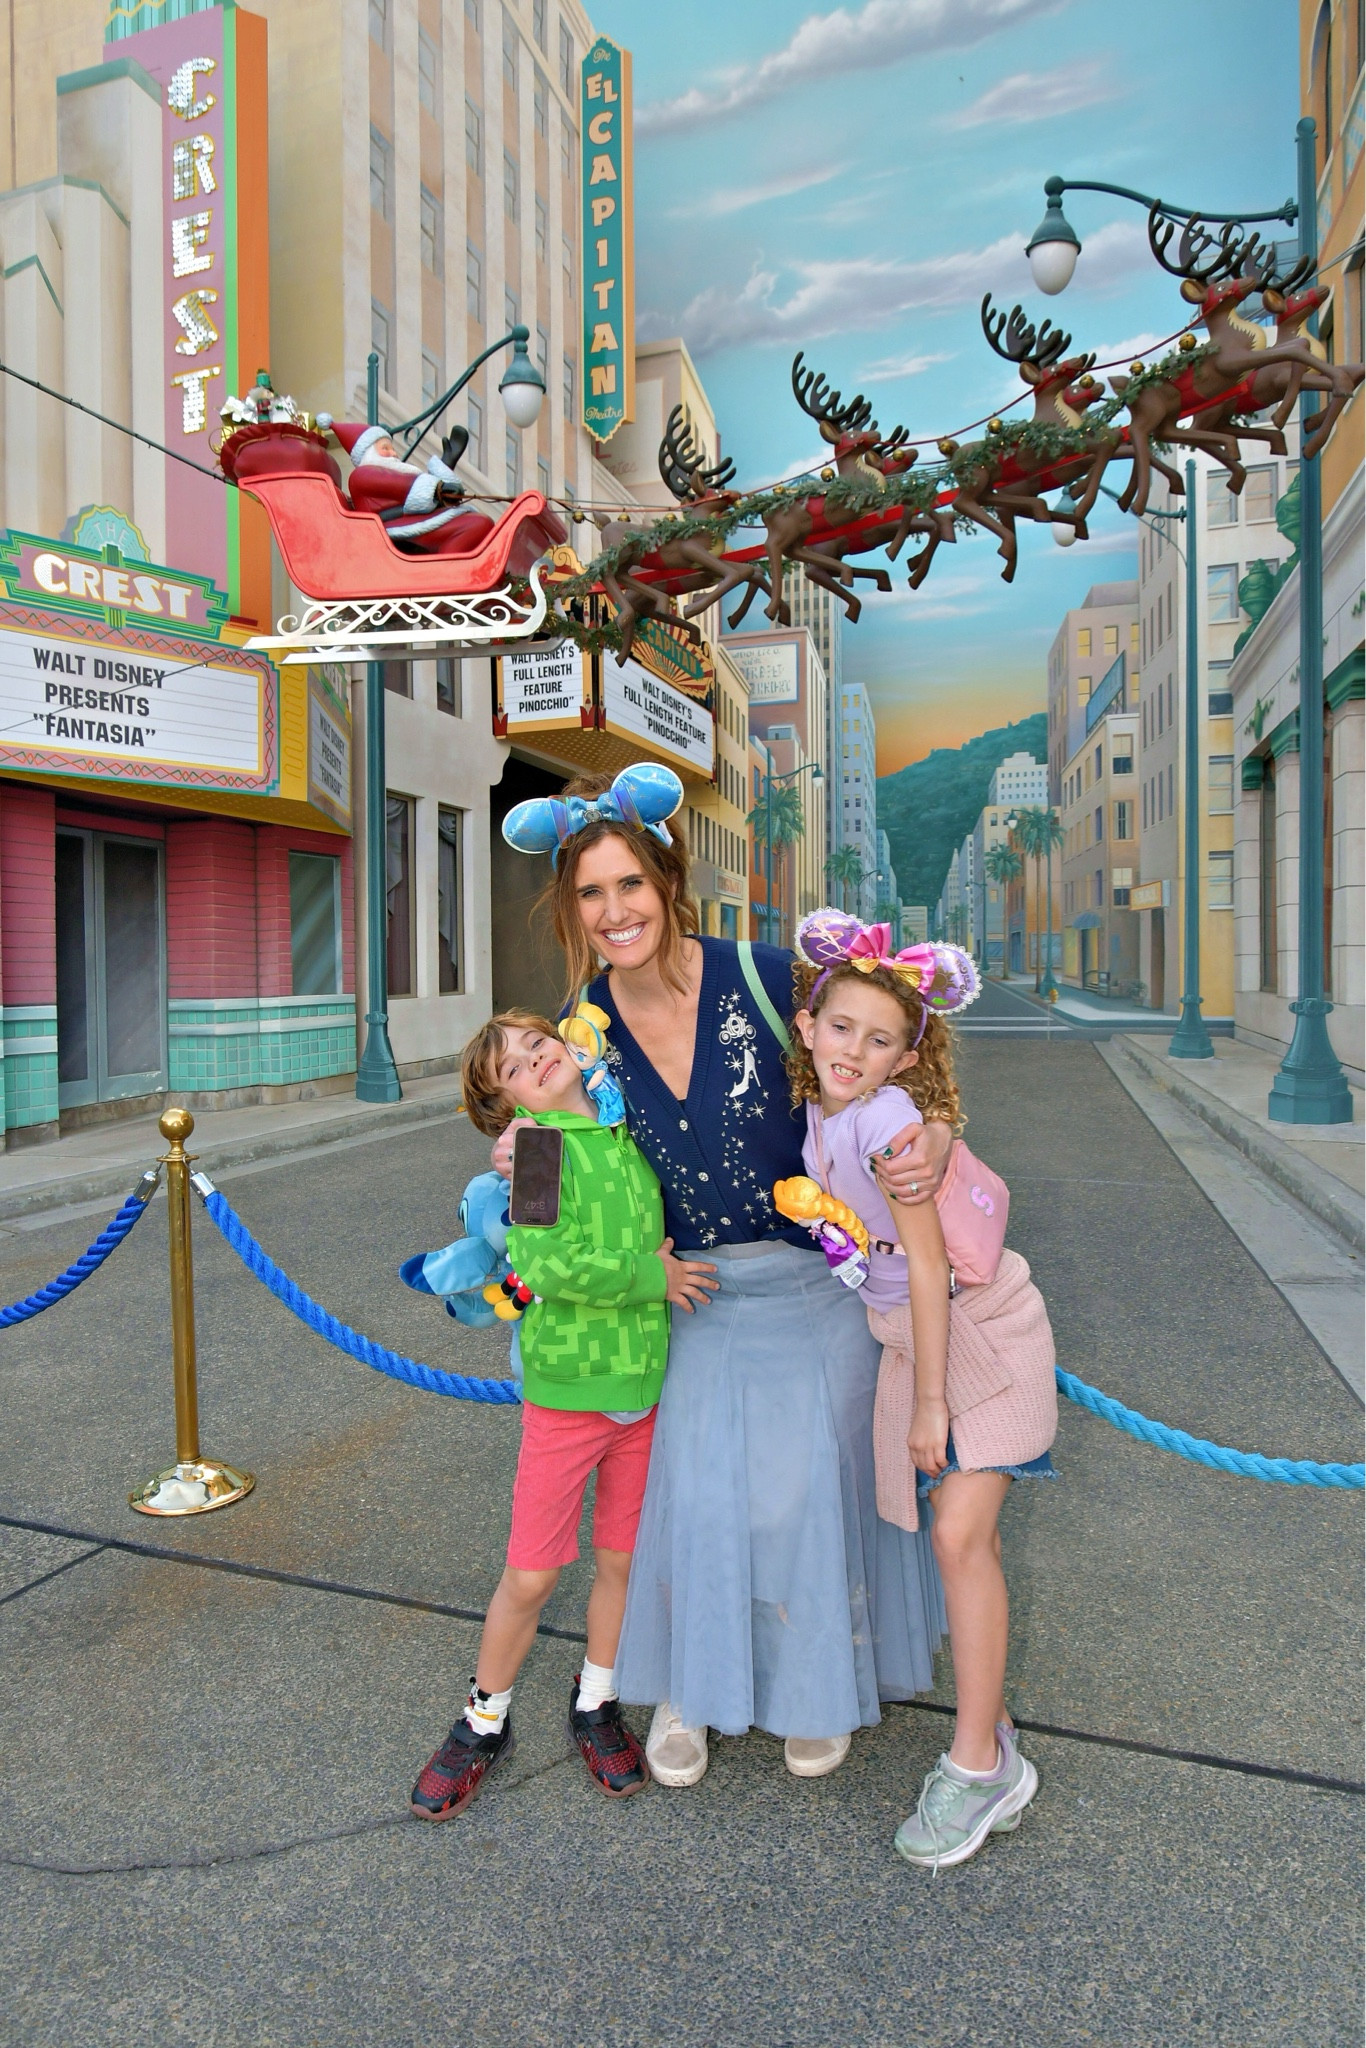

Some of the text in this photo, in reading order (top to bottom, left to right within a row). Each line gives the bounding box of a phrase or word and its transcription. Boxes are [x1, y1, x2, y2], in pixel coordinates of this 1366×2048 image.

[586, 72, 618, 104] EL
[168, 57, 222, 435] CREST
[588, 110, 619, 396] CAPITAN
[585, 406, 624, 421] Theatre
[93, 520, 129, 547] THE
[33, 553, 193, 619] CREST
[511, 645, 575, 665] WALT DISNEY'S
[646, 621, 697, 675] CAPITAN
[33, 648, 166, 689] WALT DISNEY
[513, 663, 573, 681] FULL LENGTH
[45, 682, 150, 717] PRESENTS
[523, 681, 563, 696] FEATURE
[642, 677, 693, 720] WALT DISNEY'S
[33, 713, 156, 748] "FANTASIA"
[624, 685, 707, 745] FULL LENGTH FEATURE
[643, 714, 692, 749] "PINOCCHIO"
[319, 713, 345, 757] WALT DISNEY
[321, 742, 342, 776] PRESENTS
